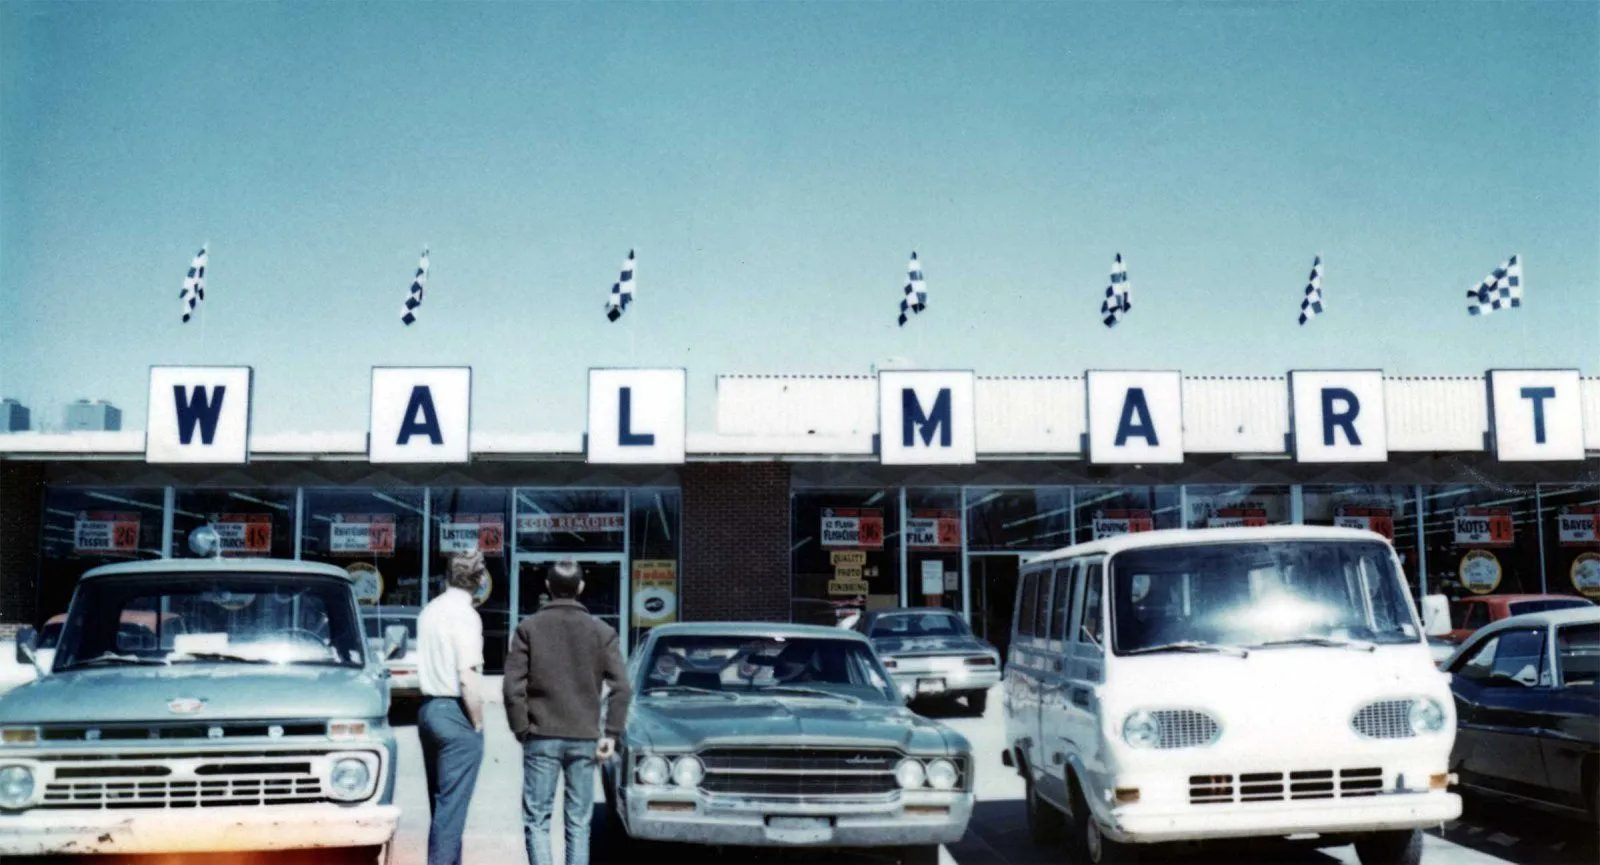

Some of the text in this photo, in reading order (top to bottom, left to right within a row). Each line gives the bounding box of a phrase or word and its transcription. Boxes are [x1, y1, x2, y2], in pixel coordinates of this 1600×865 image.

[559, 517, 622, 529] REMEDIES
[1457, 518, 1493, 534] KOTEX
[1562, 518, 1594, 531] BAYER
[906, 532, 934, 544] FILM
